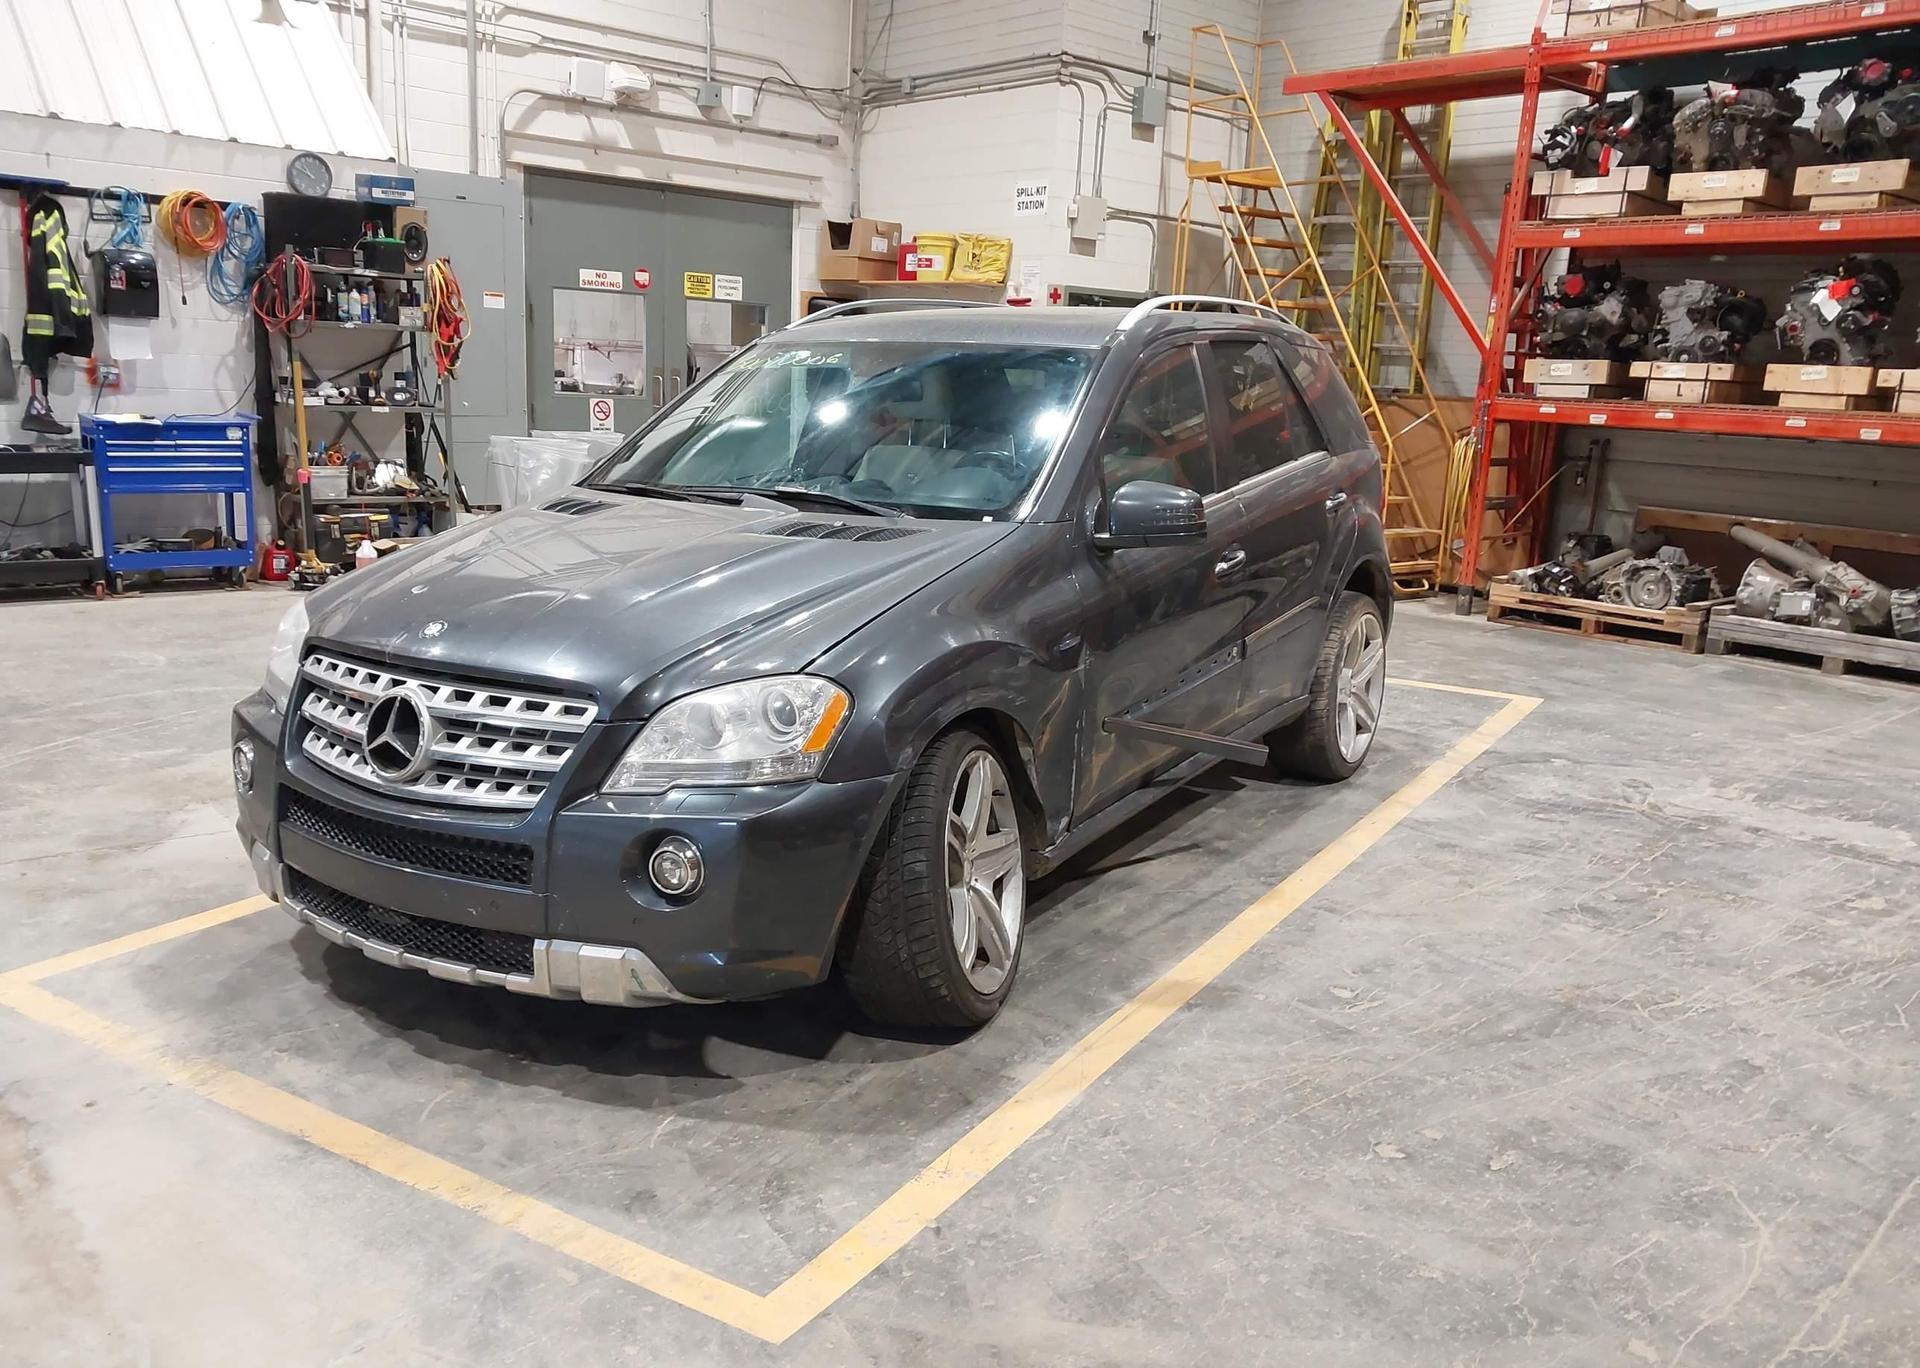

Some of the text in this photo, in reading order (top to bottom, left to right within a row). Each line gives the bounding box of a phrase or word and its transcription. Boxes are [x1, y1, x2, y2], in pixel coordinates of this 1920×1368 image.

[1016, 185, 1048, 198] SPILL-KIT
[1017, 199, 1045, 211] STATION
[595, 271, 608, 279] NO
[687, 274, 711, 284] CAUTION
[580, 279, 622, 289] SMOKING
[1676, 383, 1683, 397] L
